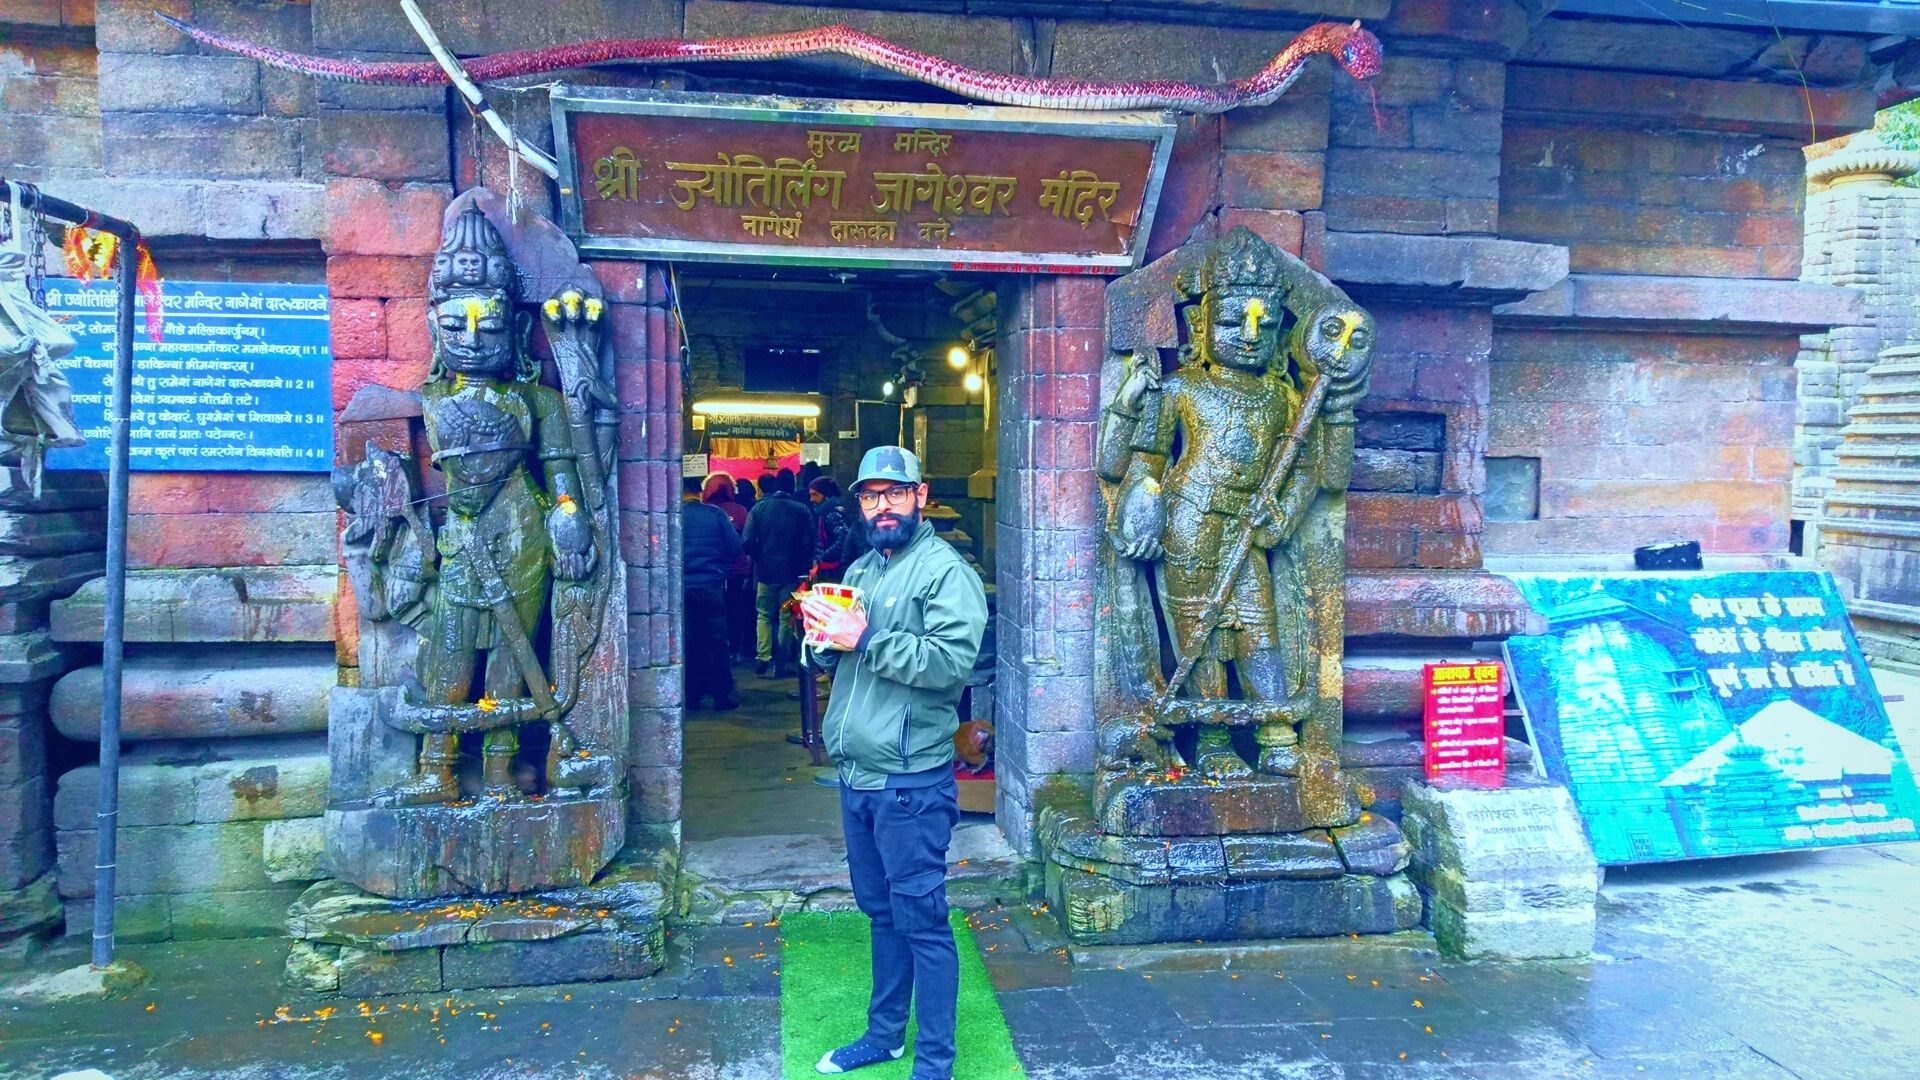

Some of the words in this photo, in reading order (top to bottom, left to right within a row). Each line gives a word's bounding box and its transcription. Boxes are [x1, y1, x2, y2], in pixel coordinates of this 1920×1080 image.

[894, 129, 953, 157] मन्दिर
[593, 146, 641, 202] श्री
[665, 151, 848, 211] ज्योतिर्लिंग
[871, 163, 1018, 216] जागेश्वर
[1039, 170, 1122, 230] मंदिर
[741, 211, 803, 240] नागेशं
[917, 217, 951, 243] वने
[46, 288, 62, 307] श्री
[184, 291, 222, 310] मन्दिर
[225, 292, 264, 310] नागेशं
